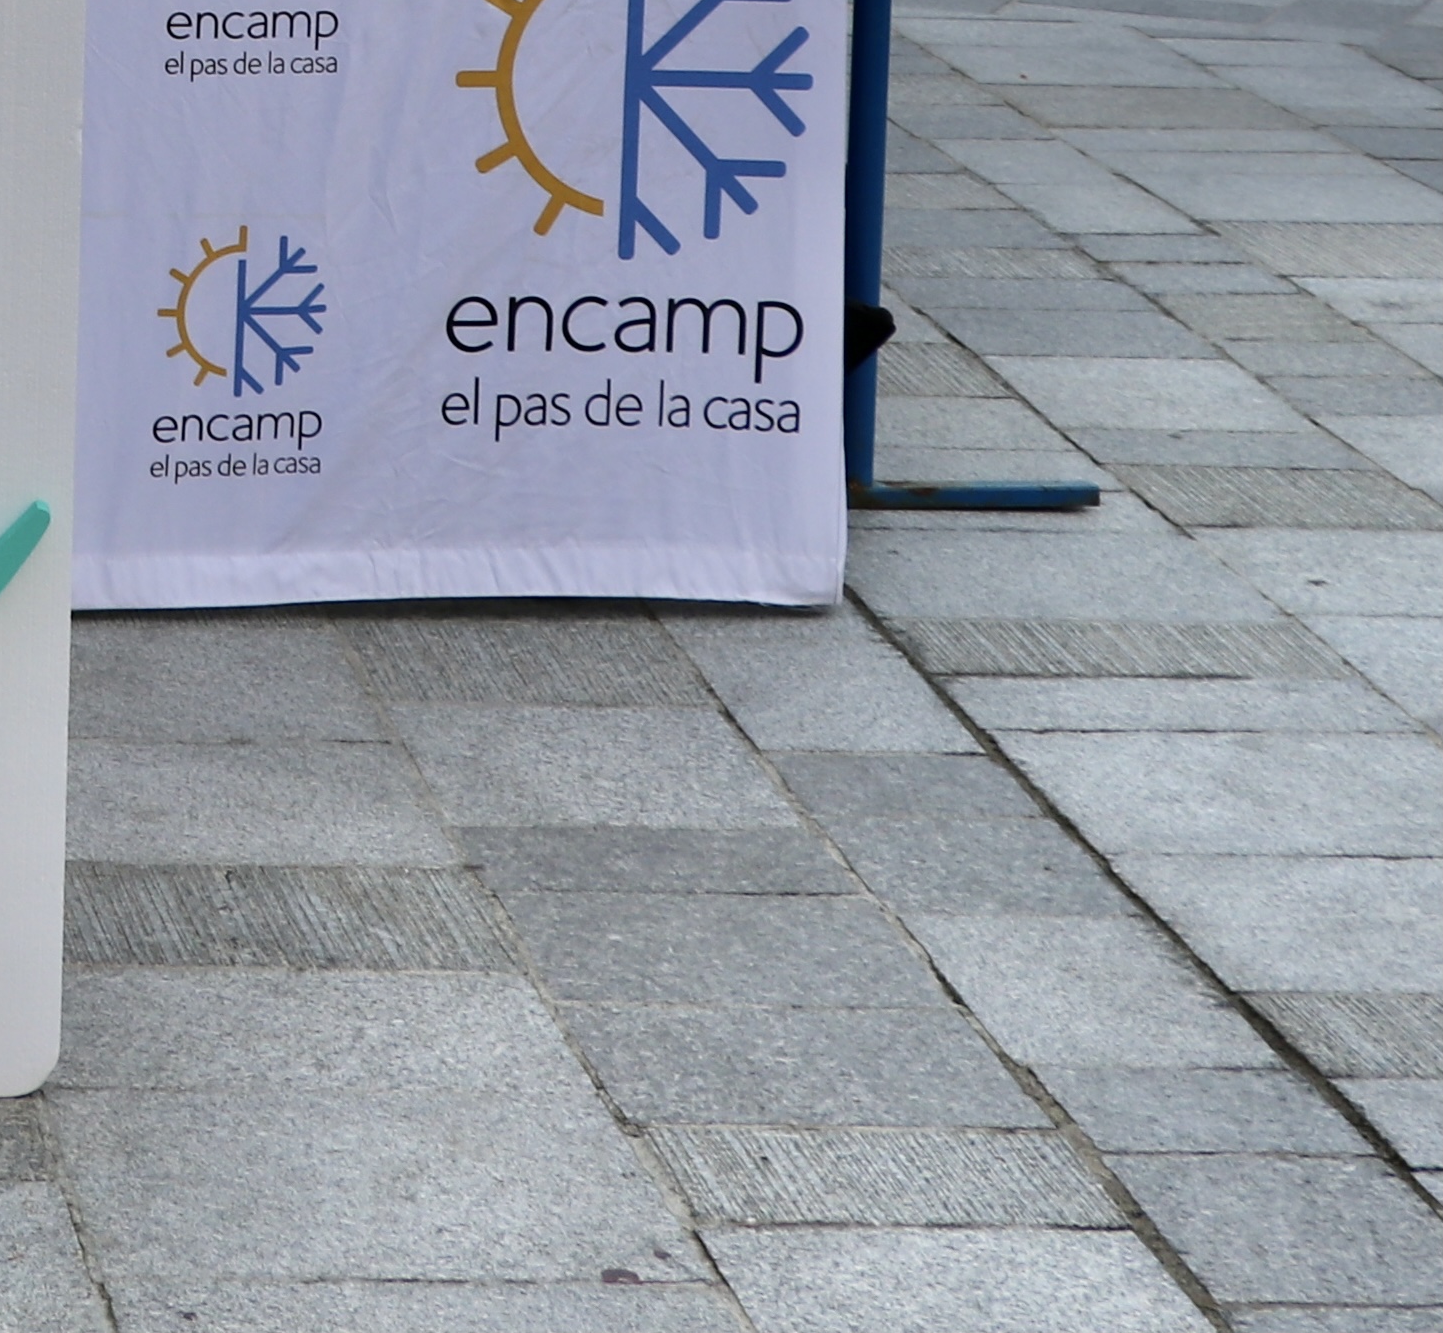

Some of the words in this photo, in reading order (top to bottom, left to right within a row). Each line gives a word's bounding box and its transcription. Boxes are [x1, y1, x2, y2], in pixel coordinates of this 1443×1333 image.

[166, 10, 339, 51] encamp
[164, 50, 185, 75] el
[190, 58, 228, 83] pas
[233, 51, 262, 75] de
[268, 50, 285, 75] la
[290, 56, 338, 74] casa
[445, 295, 804, 384] encamp
[441, 376, 480, 426] el
[494, 392, 572, 443] pas
[584, 378, 643, 427] de
[658, 379, 691, 428] la
[703, 396, 800, 434] casa
[152, 410, 323, 451] encamp
[149, 453, 170, 478] el
[174, 460, 212, 485] pas
[217, 453, 247, 477] de
[252, 452, 269, 476] la
[273, 456, 321, 474] casa
